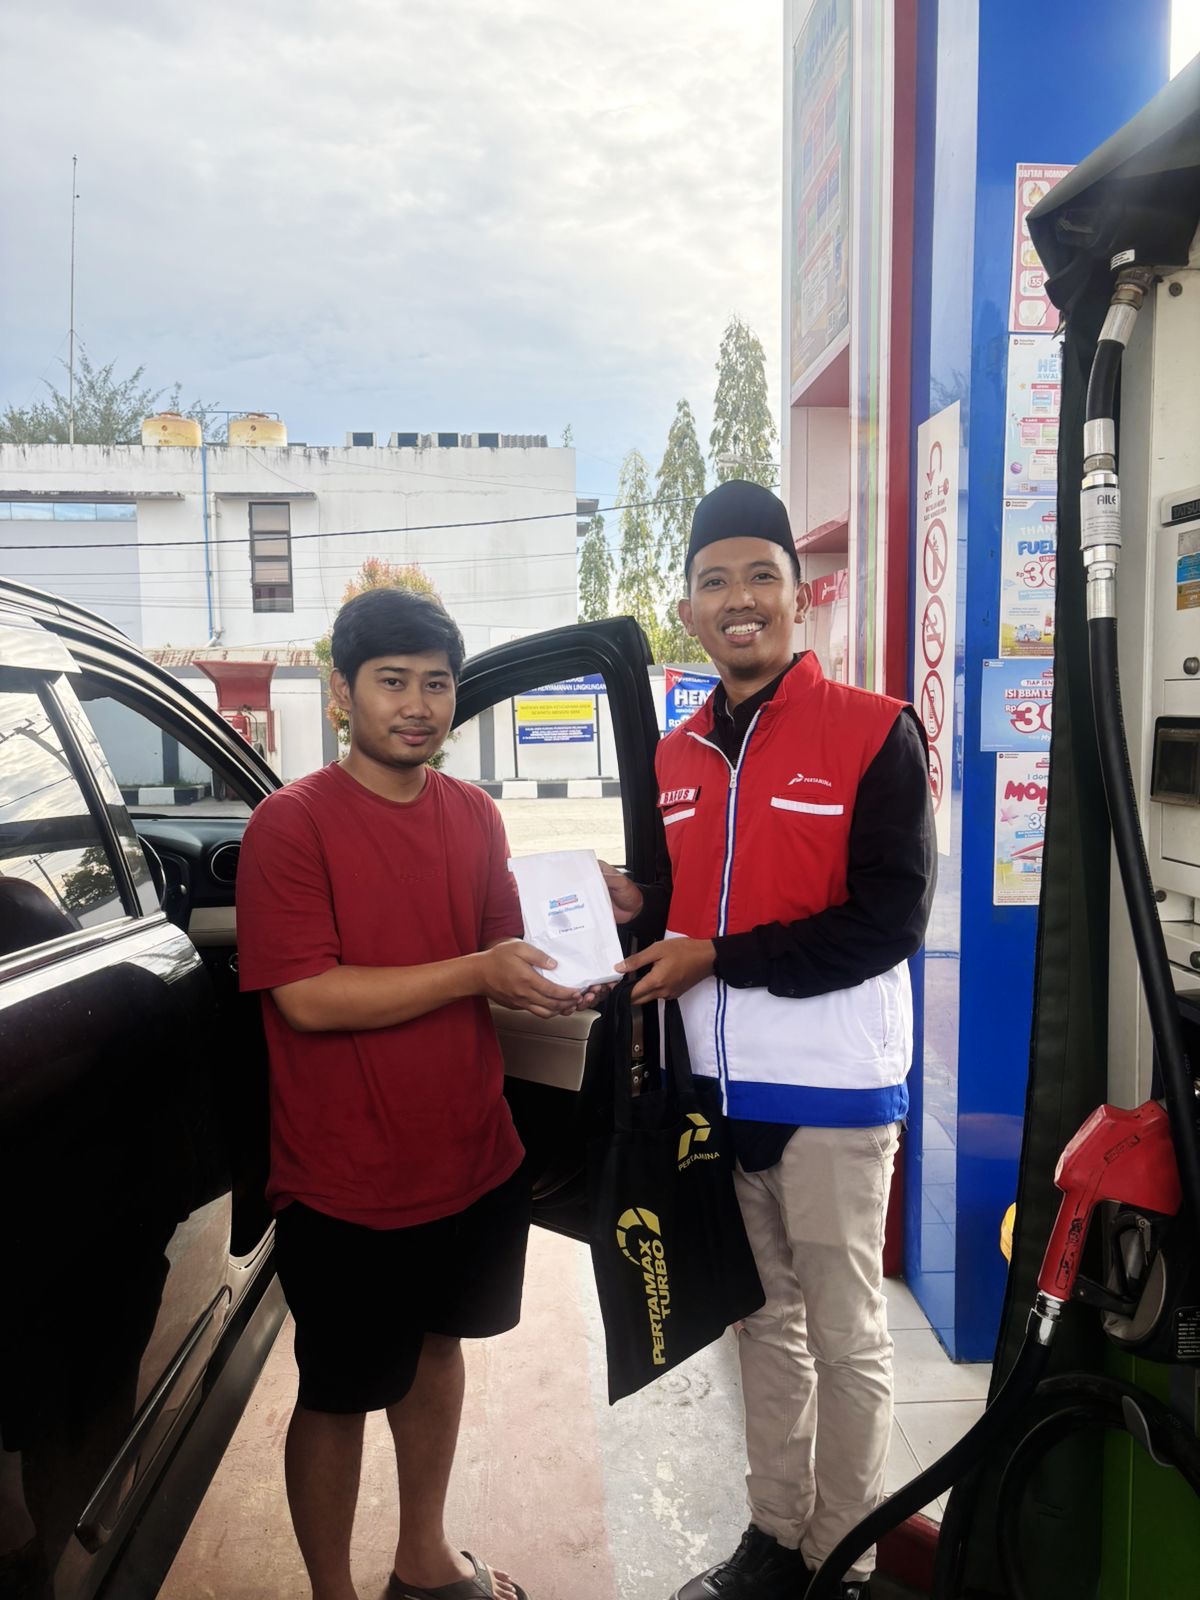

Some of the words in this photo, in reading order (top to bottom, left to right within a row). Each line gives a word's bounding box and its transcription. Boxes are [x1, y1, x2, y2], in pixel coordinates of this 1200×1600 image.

[1173, 501, 1200, 518] TATSU
[1005, 689, 1017, 698] ISI
[1018, 689, 1040, 698] BBM
[1005, 704, 1017, 713] Rp
[678, 1151, 721, 1172] PERTAMINA
[652, 1239, 672, 1320] TURBO
[639, 1239, 666, 1366] PERTAMAX
